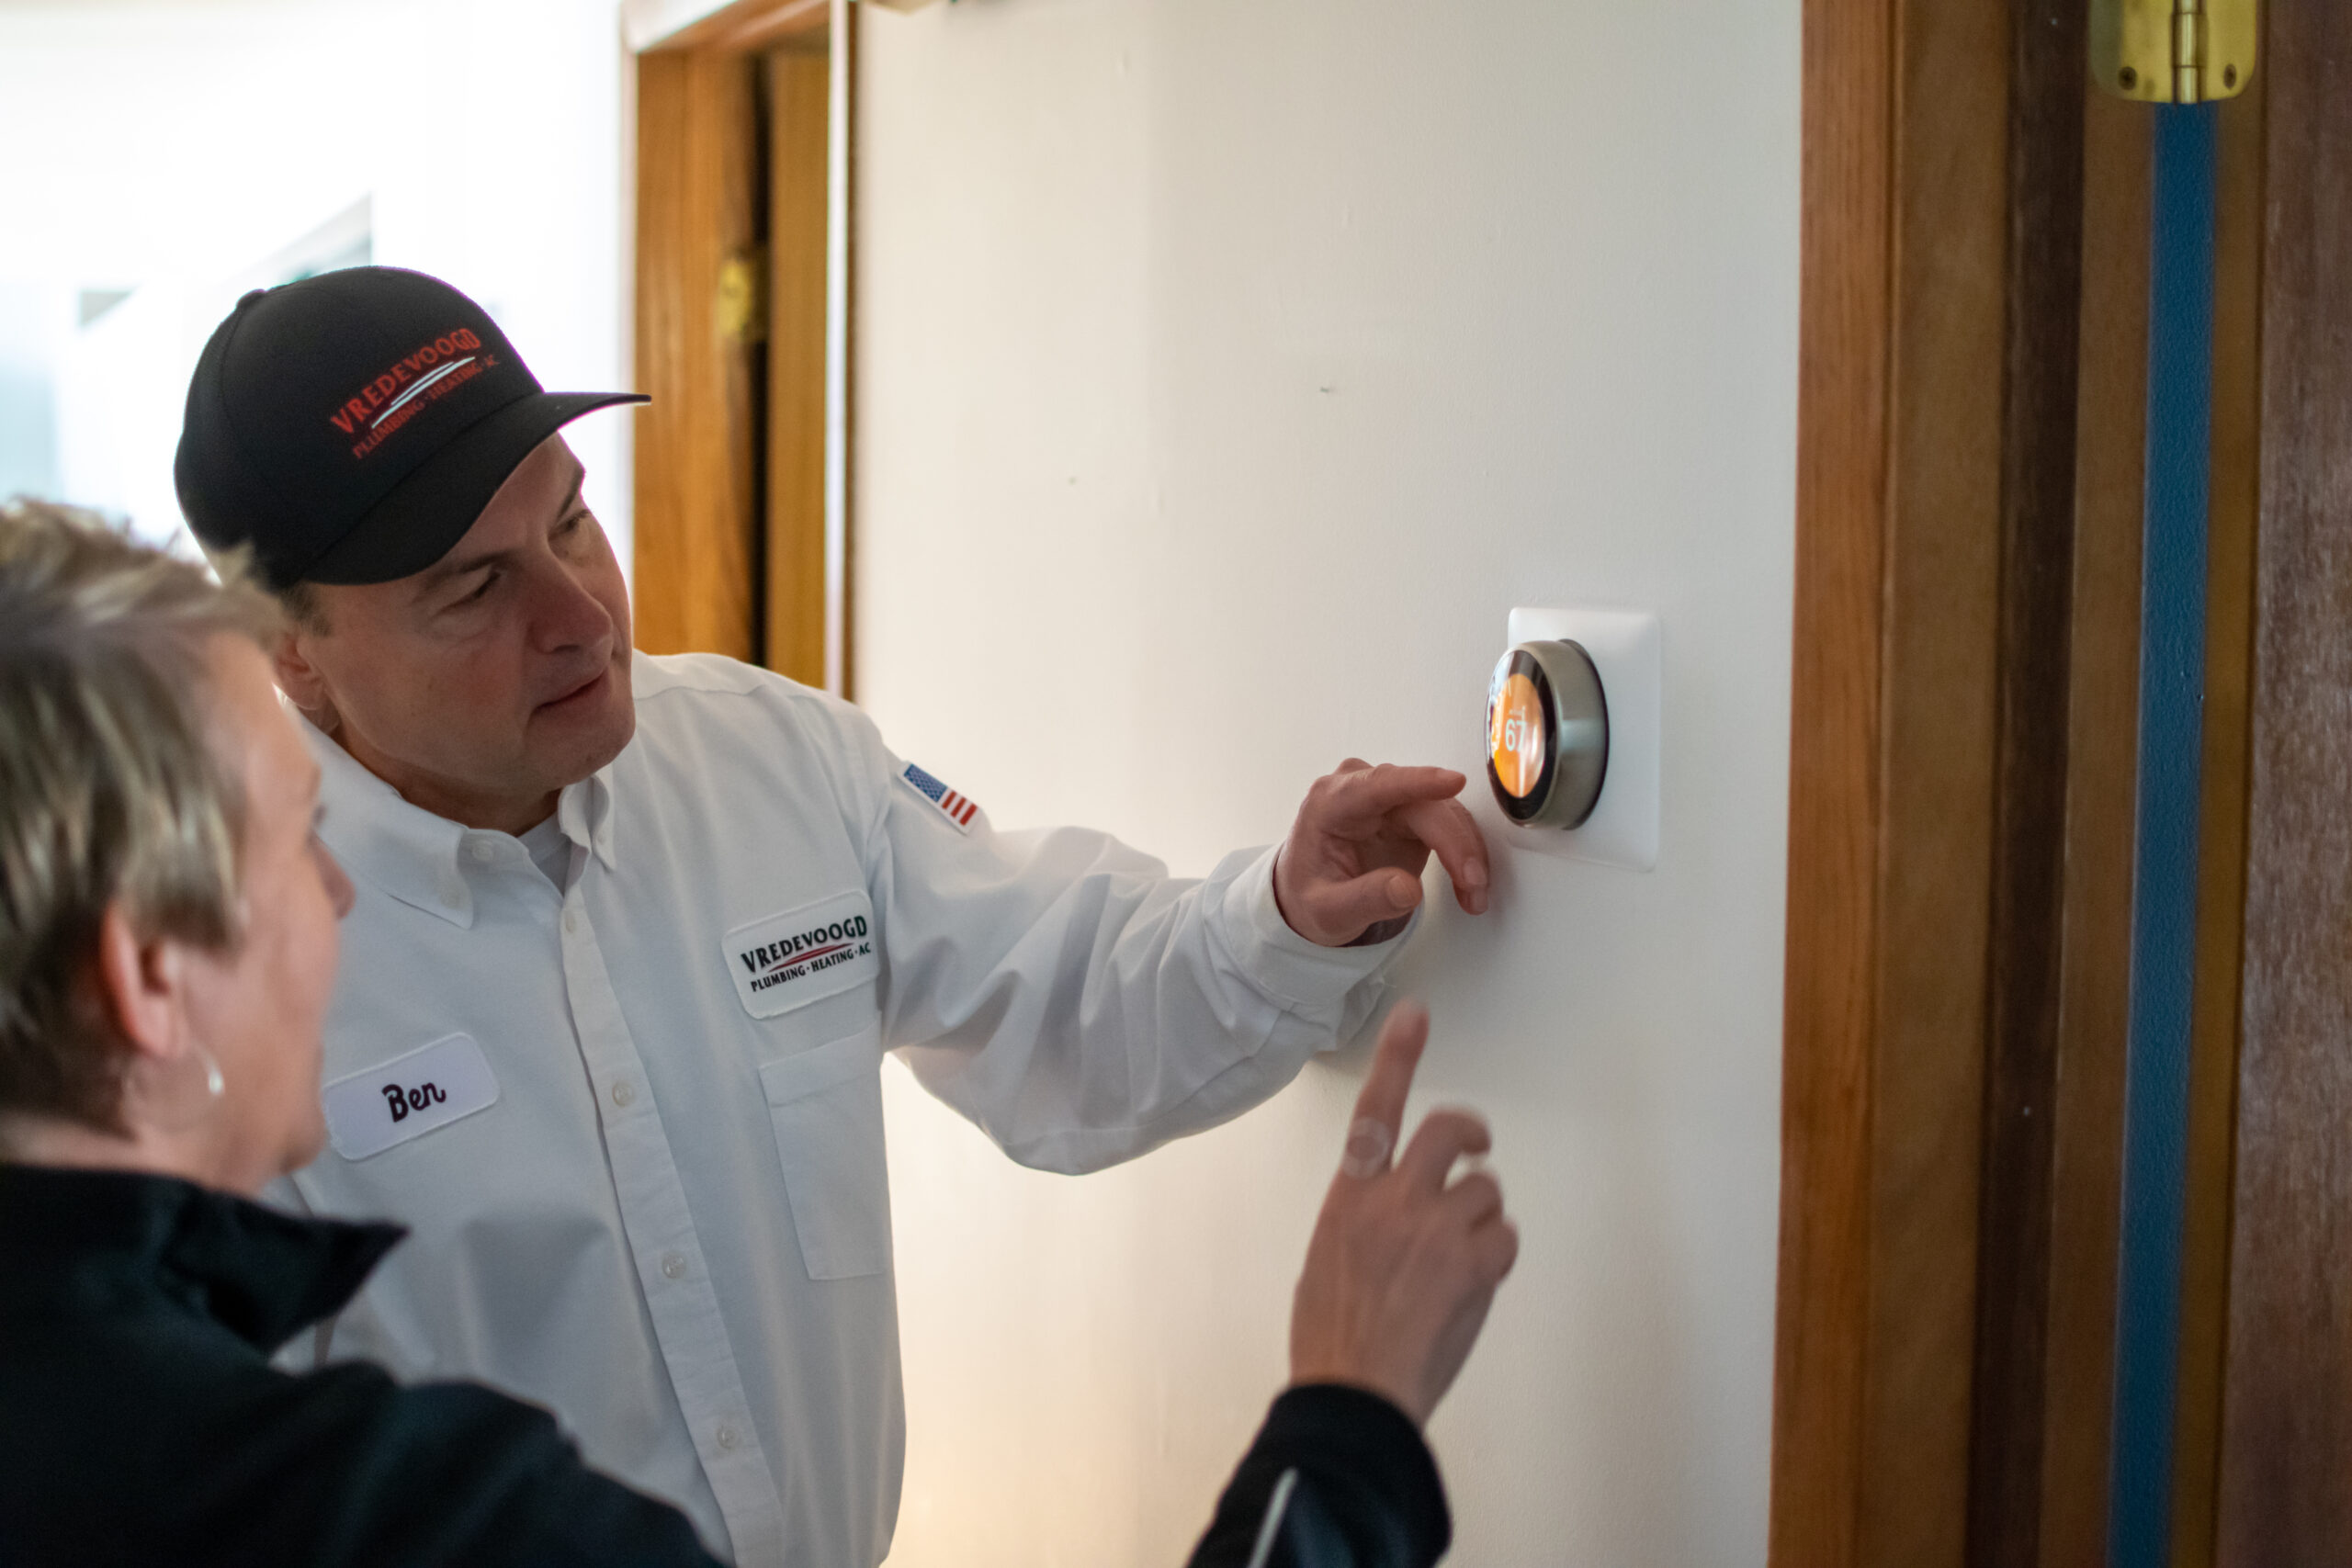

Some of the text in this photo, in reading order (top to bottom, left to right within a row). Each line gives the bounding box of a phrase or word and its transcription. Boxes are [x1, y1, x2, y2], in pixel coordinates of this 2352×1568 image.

[331, 329, 481, 433] VREDEVOOGD
[353, 400, 424, 459] PLUMBING
[1505, 720, 1526, 751] 67
[741, 916, 867, 974] VREDEVOOGD
[751, 942, 871, 992] PLUMBING HEATING AC
[382, 1083, 447, 1122] Ben
